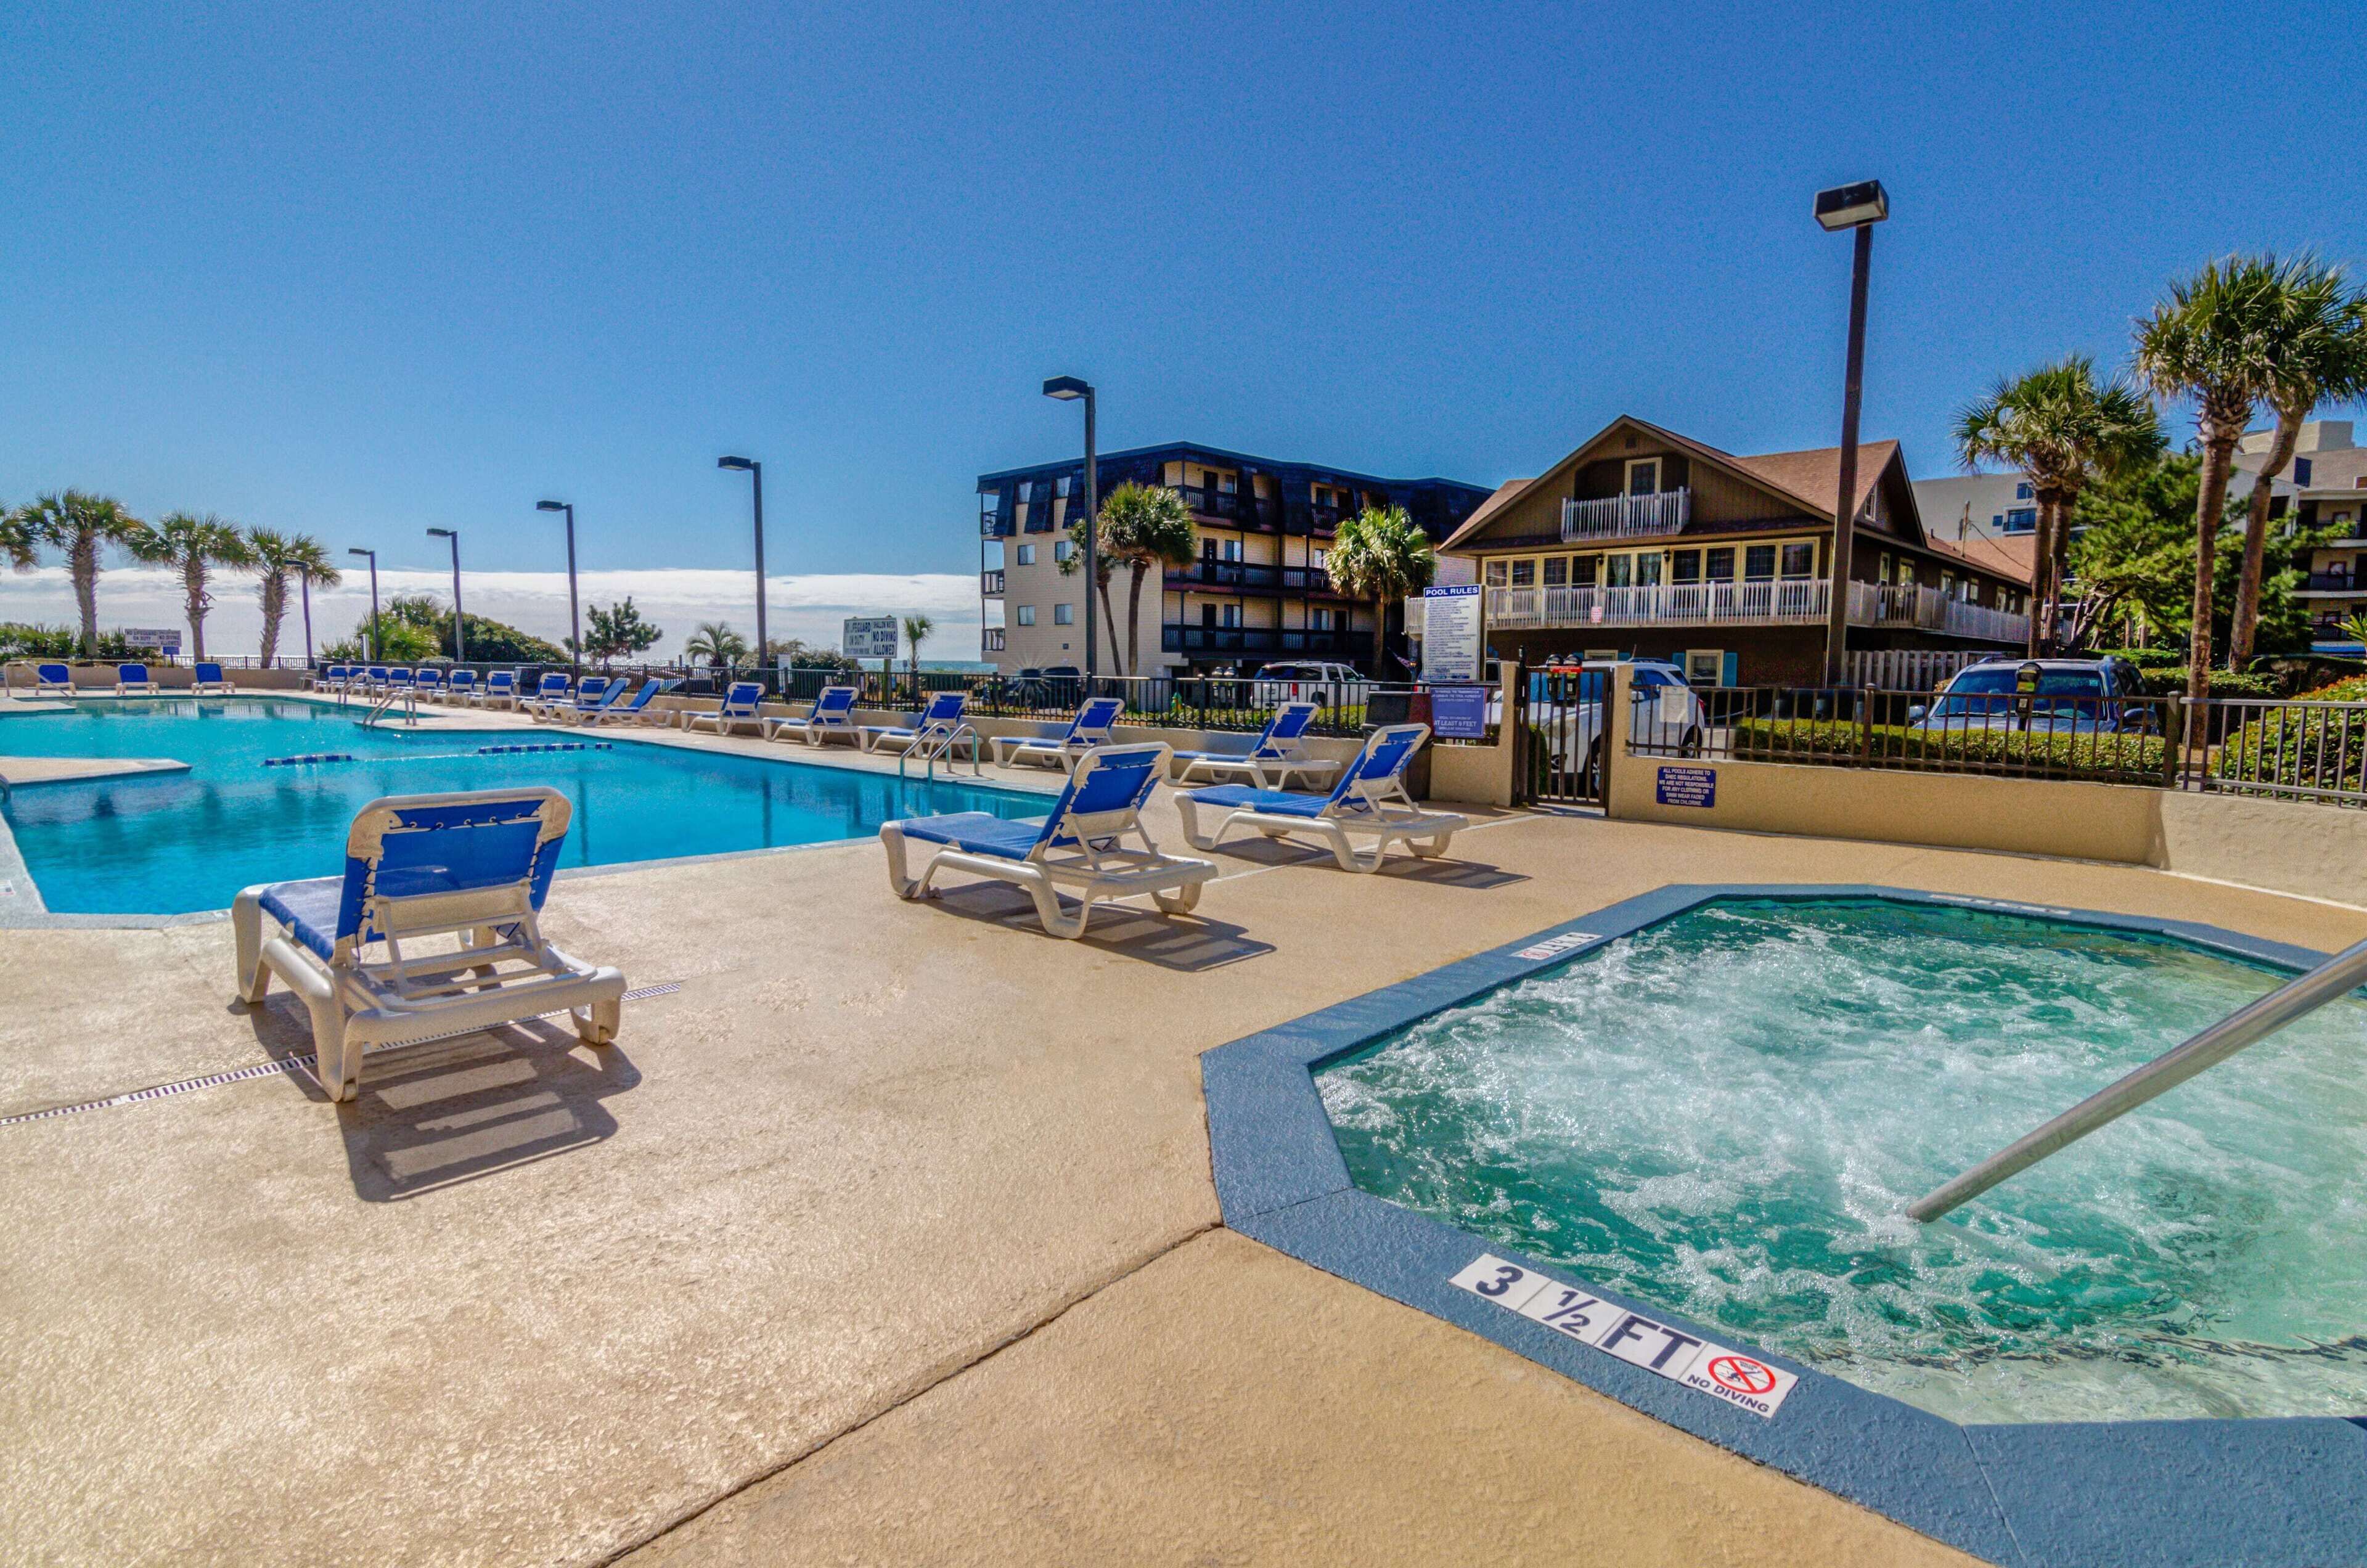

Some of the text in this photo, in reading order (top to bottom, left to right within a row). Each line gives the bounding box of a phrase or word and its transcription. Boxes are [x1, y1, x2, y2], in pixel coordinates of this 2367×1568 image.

[873, 631, 896, 642] NO DIVING
[873, 644, 895, 655] ALLOWED
[1476, 1266, 1524, 1296] 3
[1601, 1314, 1702, 1370] FT
[1686, 1374, 1770, 1413] NO DIVING
